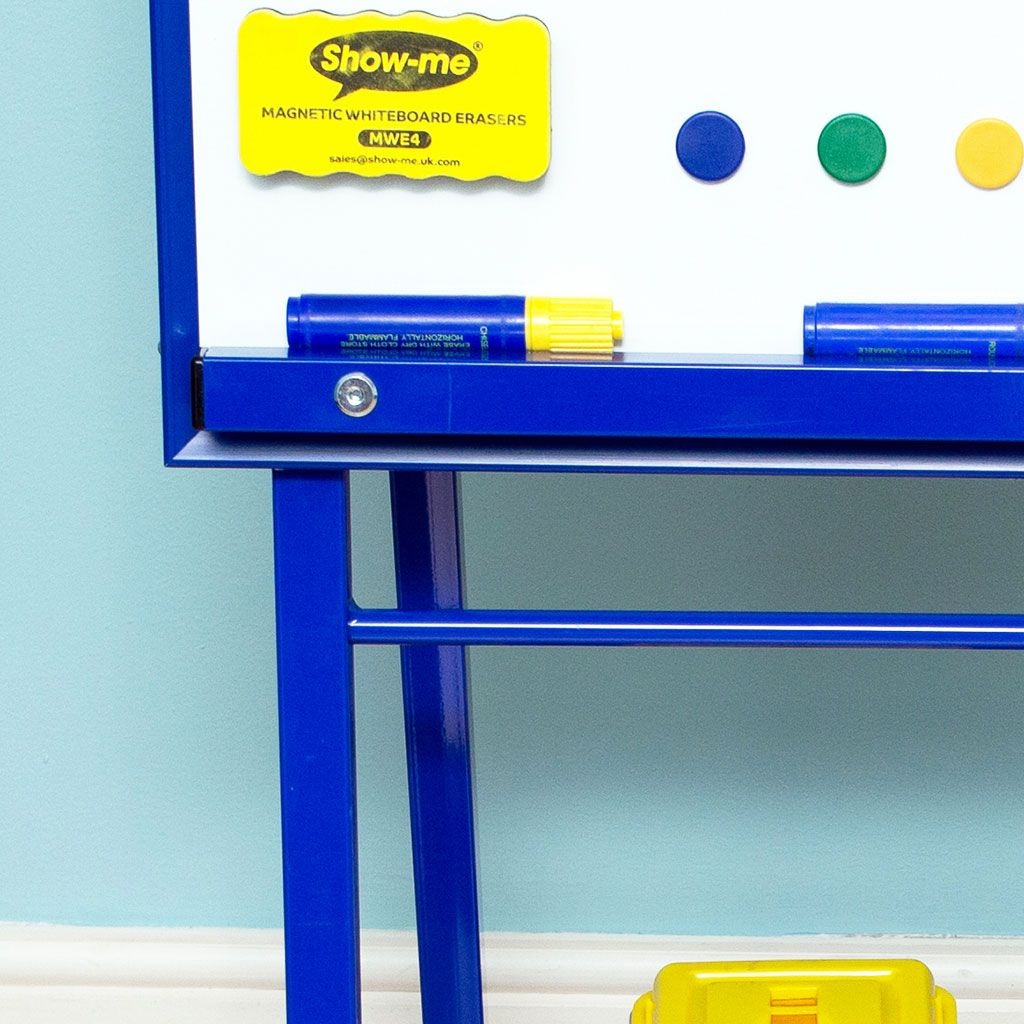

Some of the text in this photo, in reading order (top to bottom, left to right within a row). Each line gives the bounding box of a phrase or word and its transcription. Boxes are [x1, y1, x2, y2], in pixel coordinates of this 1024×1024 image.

[320, 43, 471, 76] Show-me
[261, 106, 527, 126] MAGNETIC WHITEBOARD ERASERS
[368, 131, 421, 146] MWE4
[329, 154, 461, 166] sales@show-me.uk.com
